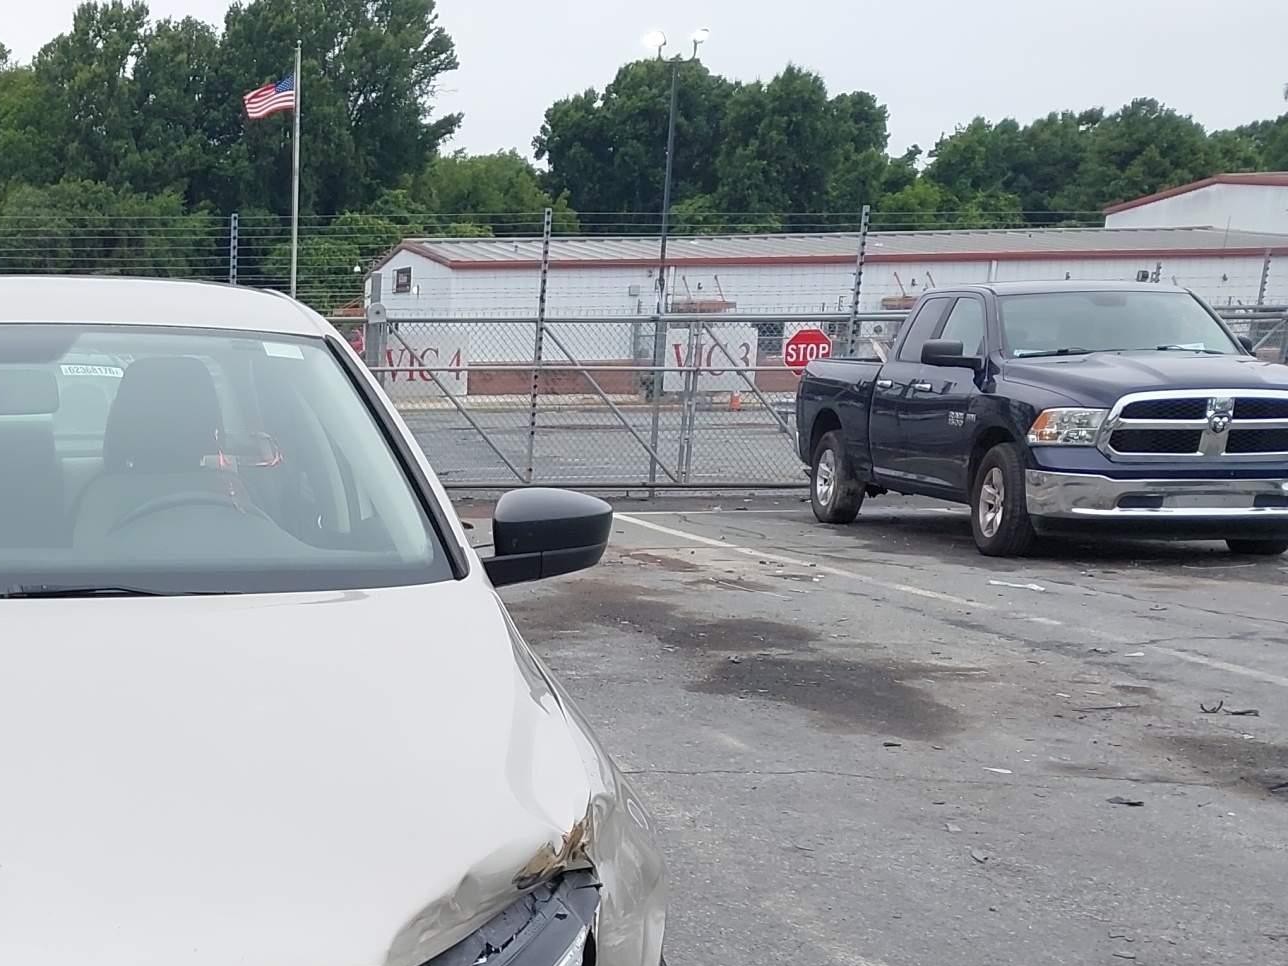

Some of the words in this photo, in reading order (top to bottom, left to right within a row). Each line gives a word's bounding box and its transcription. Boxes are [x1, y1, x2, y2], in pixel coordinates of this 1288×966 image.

[386, 347, 439, 382] VIC
[448, 347, 463, 381] 4
[738, 342, 751, 375] 3
[787, 344, 829, 362] STOP
